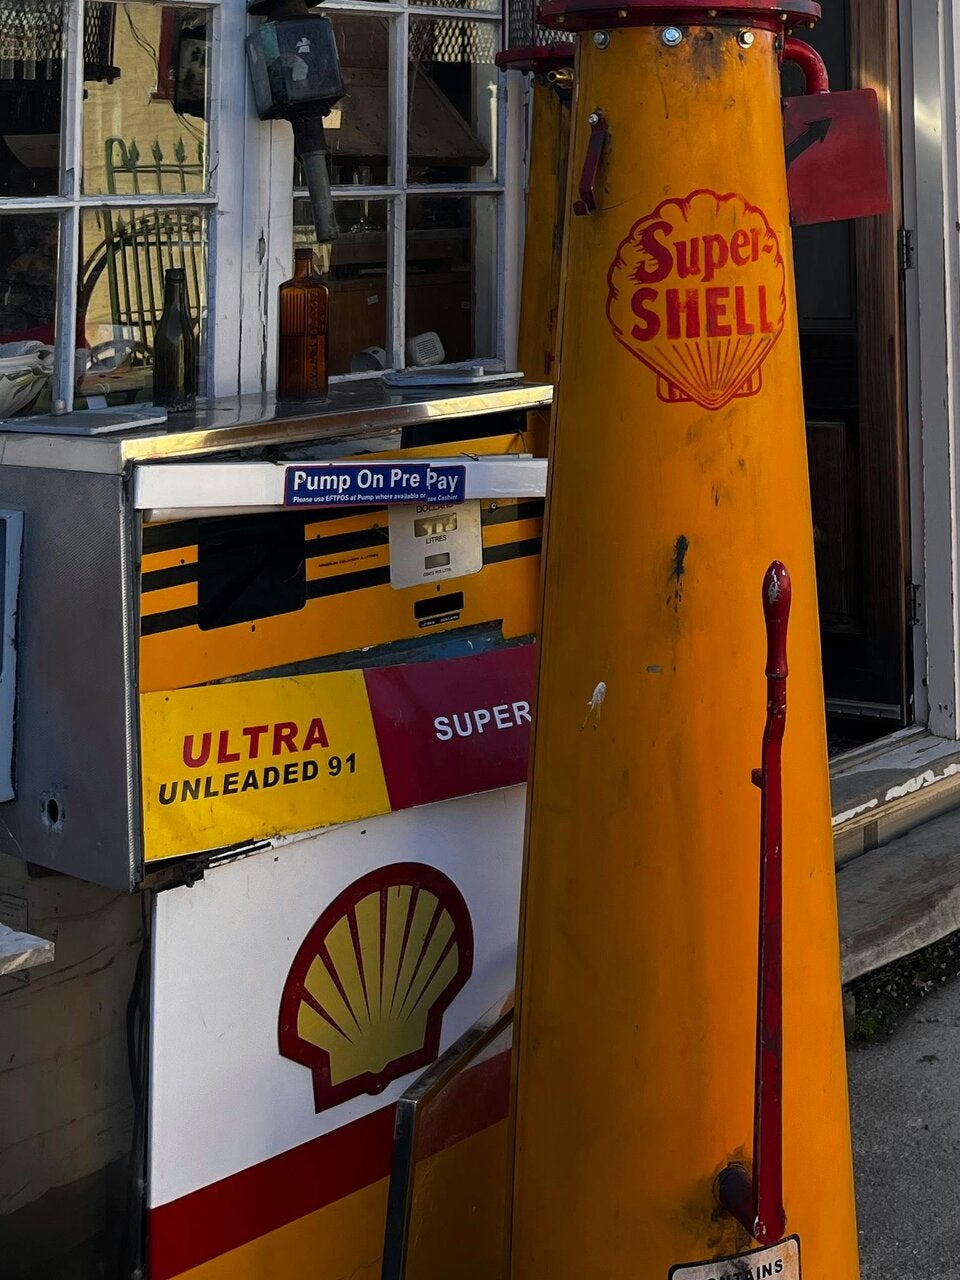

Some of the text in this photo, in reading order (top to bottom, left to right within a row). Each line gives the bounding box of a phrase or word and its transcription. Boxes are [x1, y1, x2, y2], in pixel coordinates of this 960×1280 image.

[630, 284, 775, 343] SHELL
[293, 468, 459, 493] Pump On Pre Pay
[293, 495, 313, 503] Please
[325, 494, 350, 502] EFTPOS
[425, 535, 448, 545] LITRES
[435, 700, 533, 741] SUPER
[181, 717, 330, 769] ULTRA
[158, 753, 358, 806] UNLEADED 91
